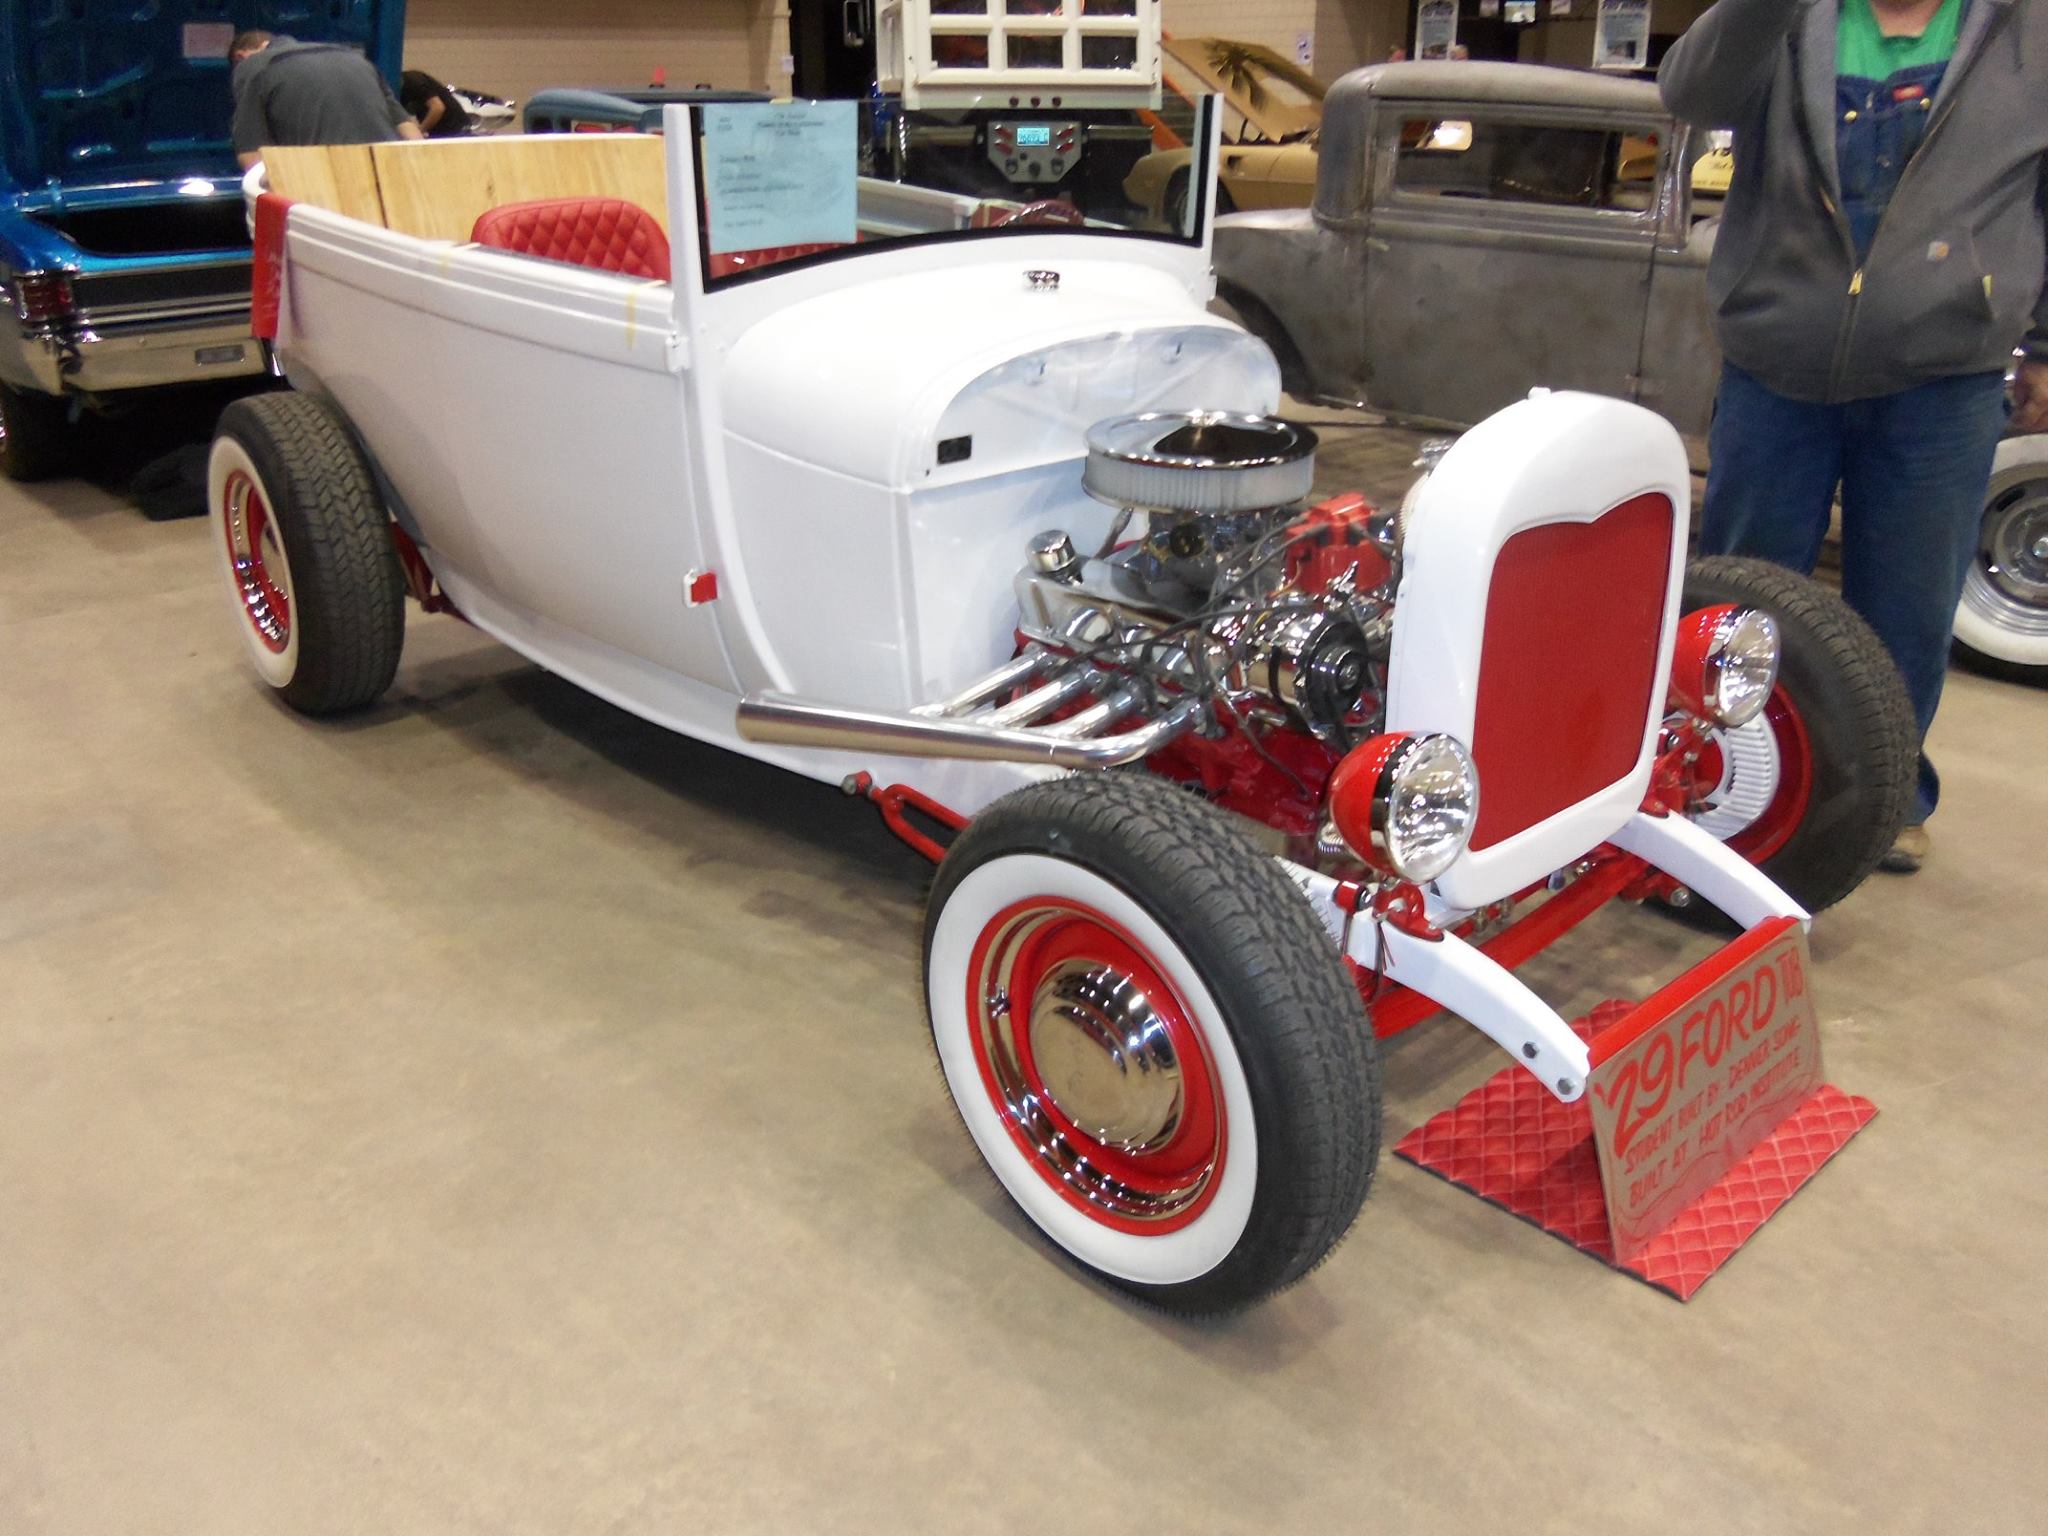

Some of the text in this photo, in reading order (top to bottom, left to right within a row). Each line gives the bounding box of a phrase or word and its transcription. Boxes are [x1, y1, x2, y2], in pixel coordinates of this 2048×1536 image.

[1594, 1031, 1674, 1160] '29
[1678, 965, 1777, 1090] FORD
[1630, 1158, 1667, 1209] BUILT
[1673, 1140, 1689, 1168] AT
[1699, 1110, 1724, 1146] HOT
[1726, 1092, 1749, 1124] ROD
